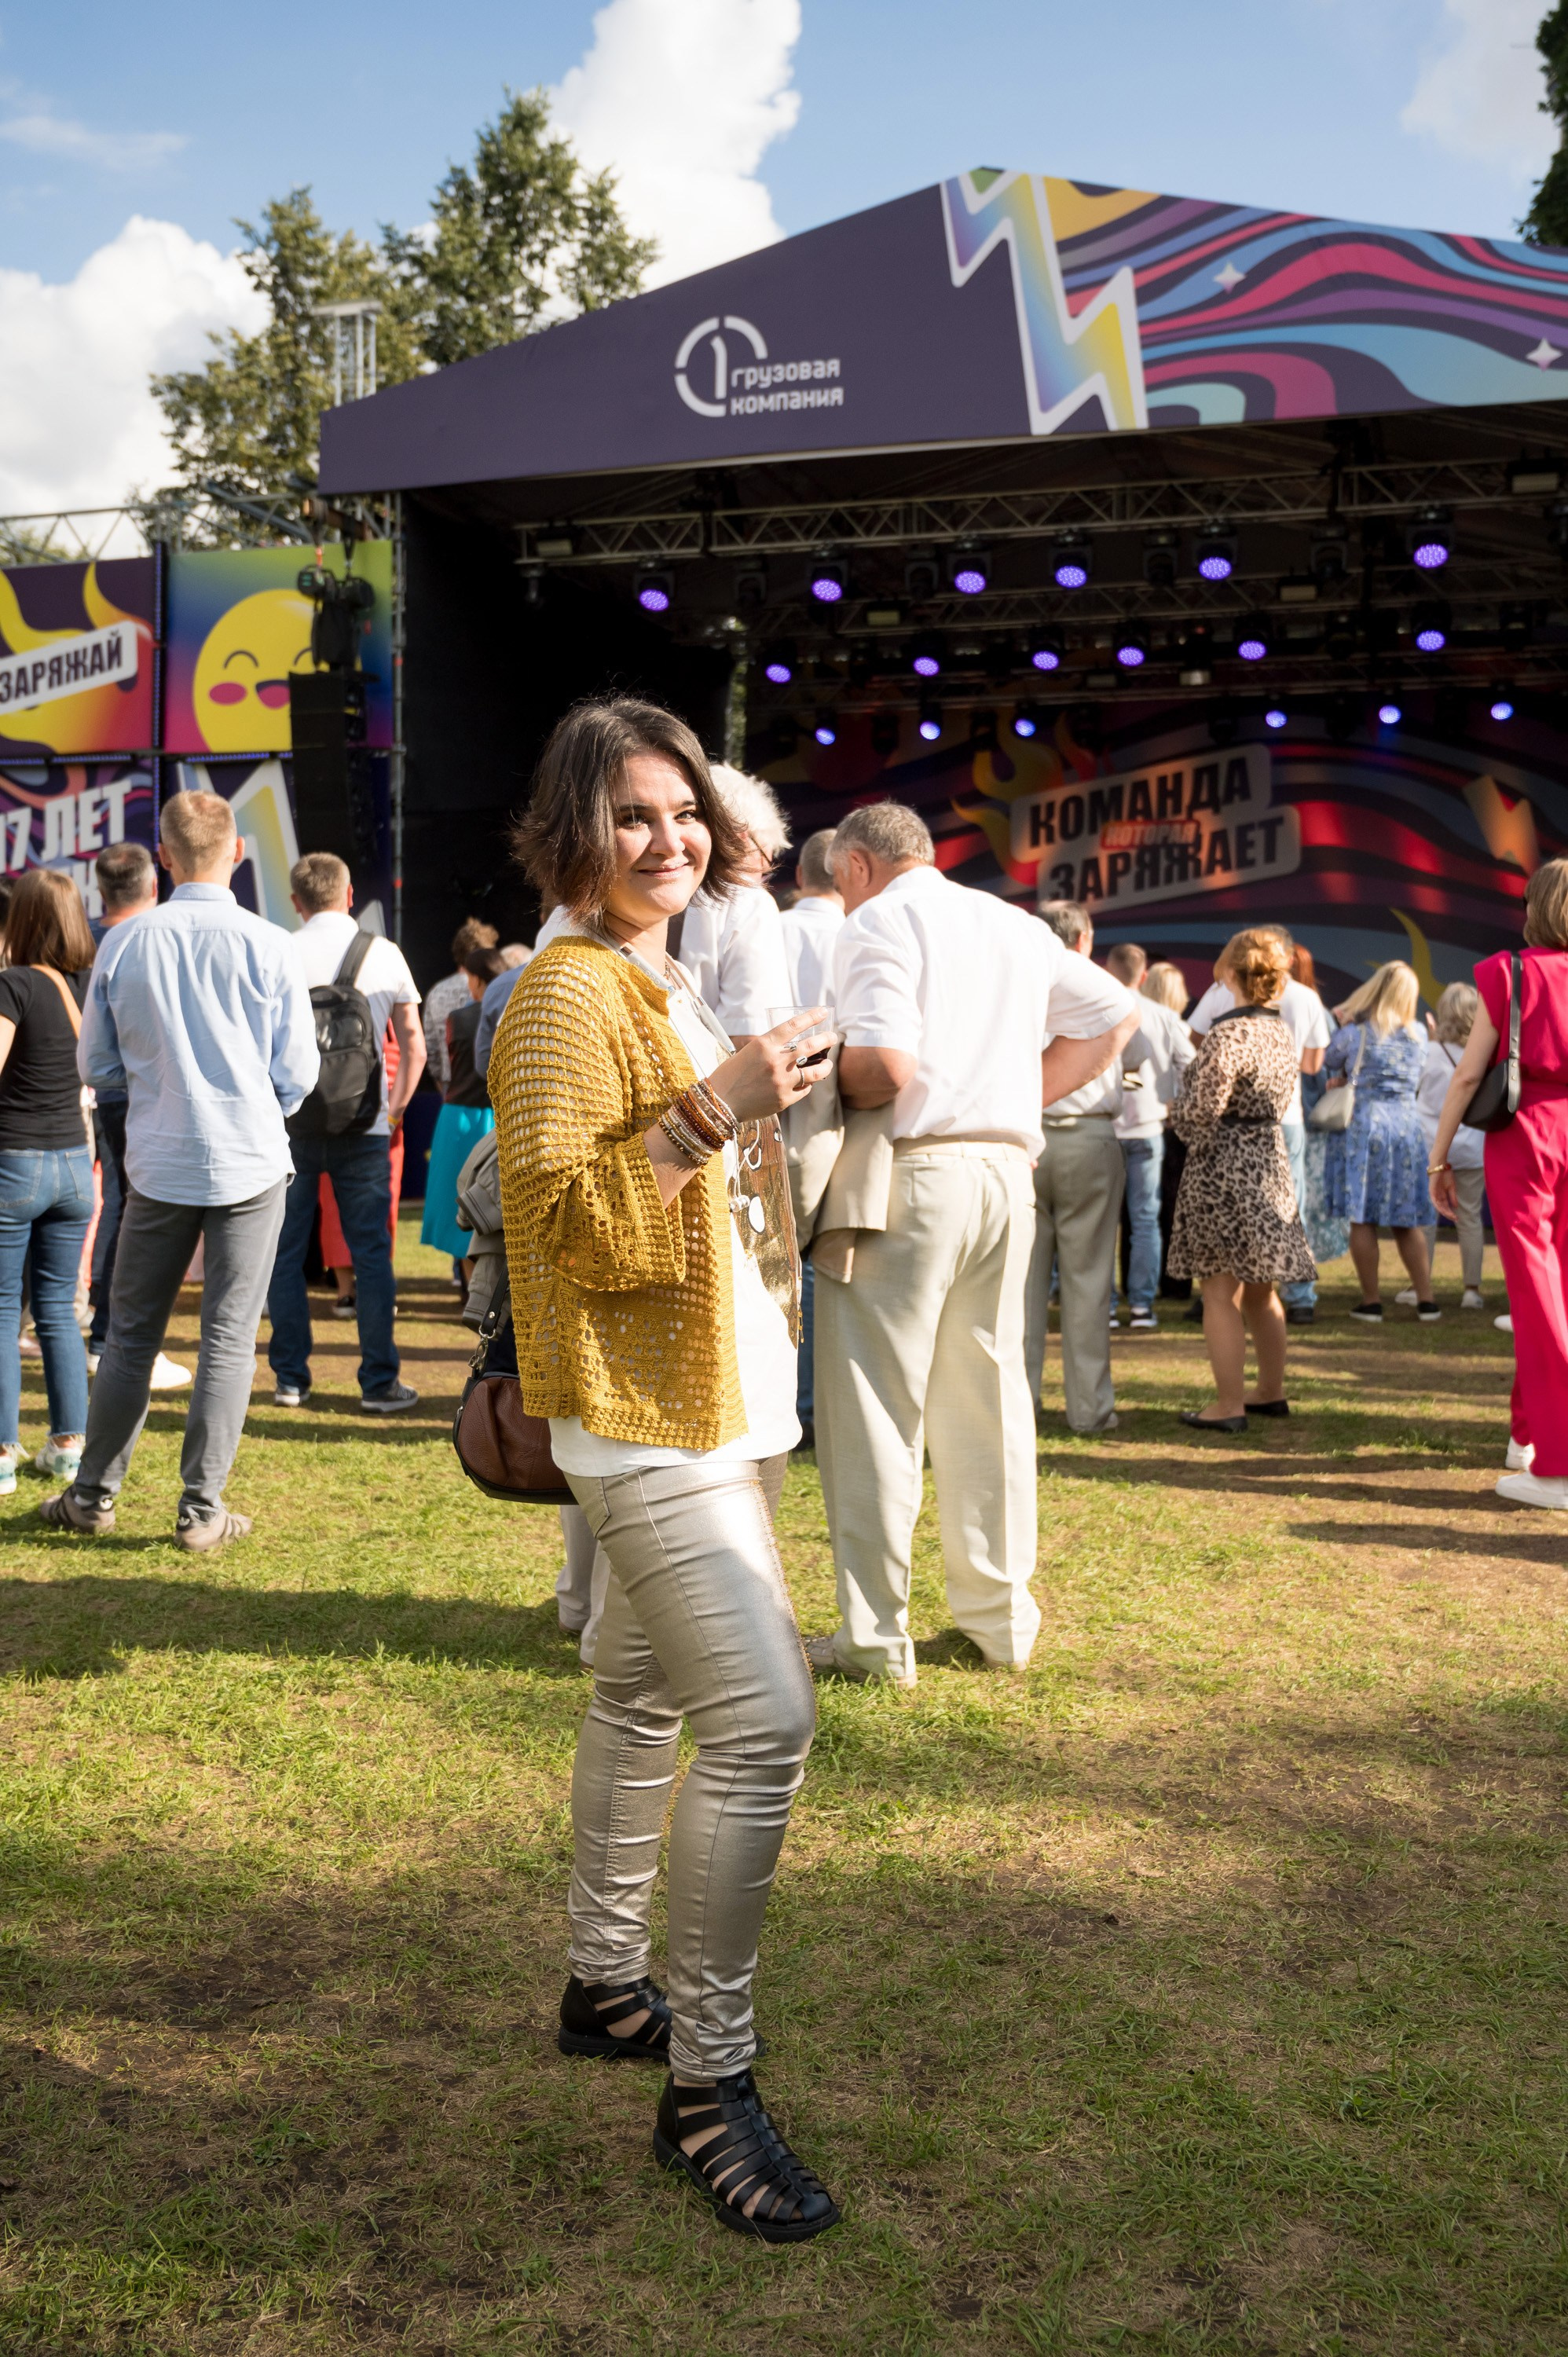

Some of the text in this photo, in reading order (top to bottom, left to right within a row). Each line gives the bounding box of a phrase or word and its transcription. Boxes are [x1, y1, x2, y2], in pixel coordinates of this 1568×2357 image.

[731, 359, 841, 389] грузовая
[731, 387, 844, 416] компания
[0, 630, 122, 702] ЗАРЯЖАЙ
[41, 779, 132, 863] ЛЕТ
[1030, 758, 1251, 846] КОМАНДА
[1050, 818, 1284, 903] ЗАРЯЖАЕТ
